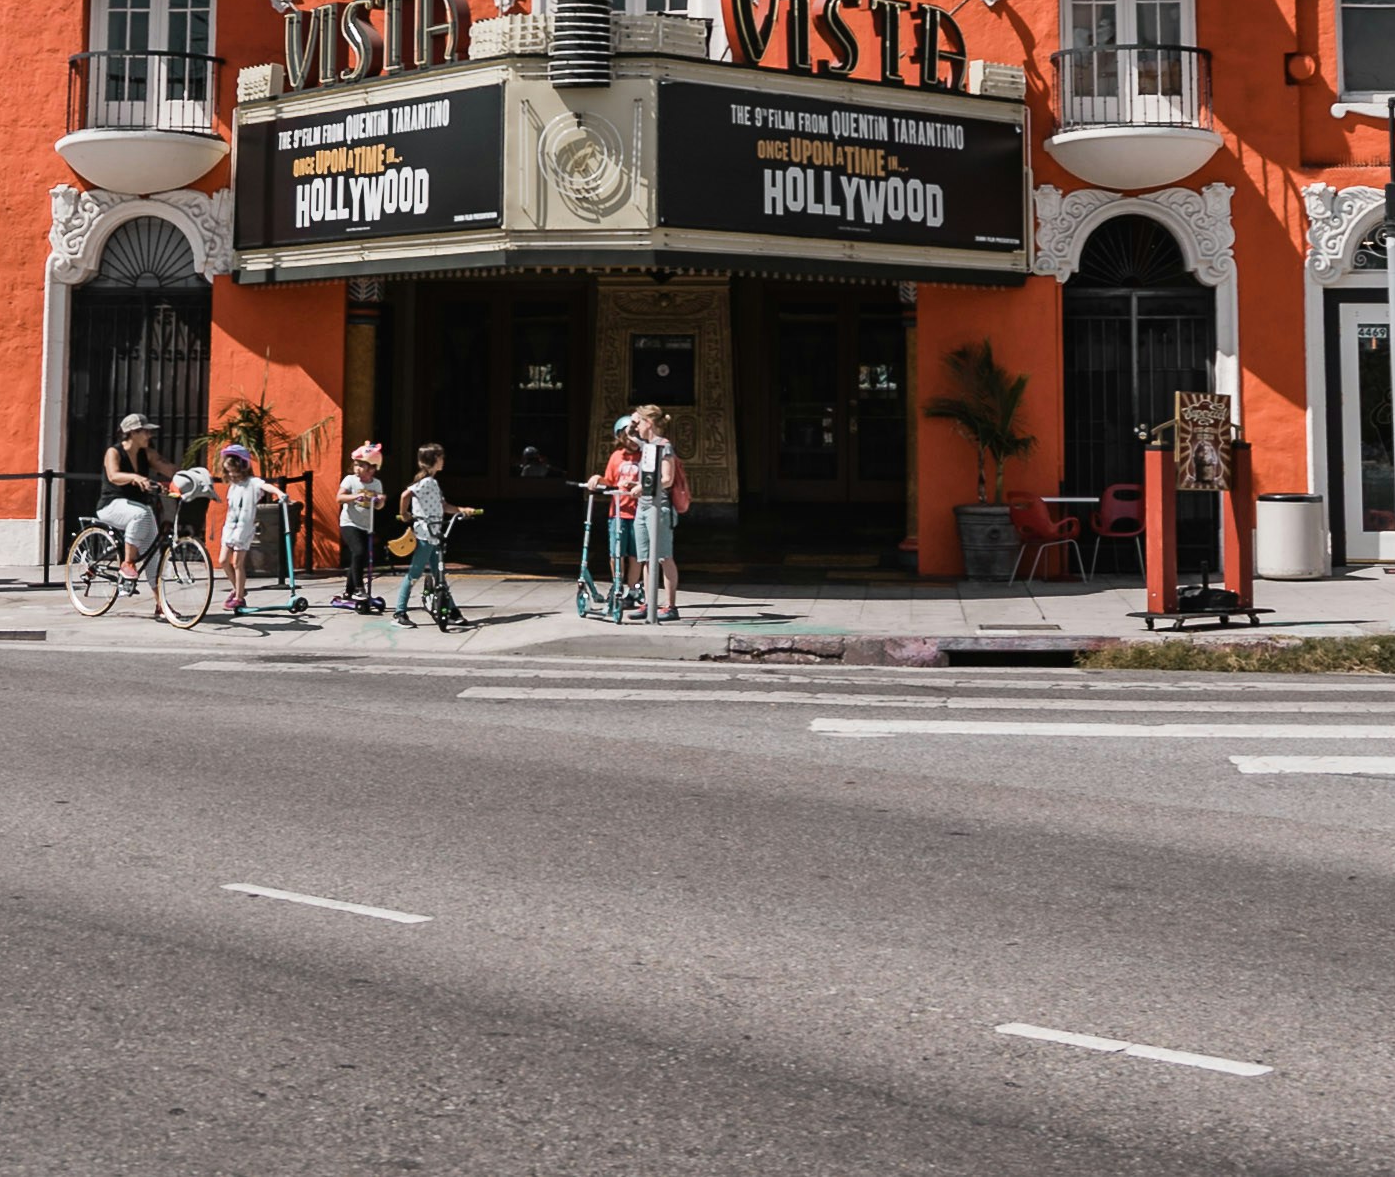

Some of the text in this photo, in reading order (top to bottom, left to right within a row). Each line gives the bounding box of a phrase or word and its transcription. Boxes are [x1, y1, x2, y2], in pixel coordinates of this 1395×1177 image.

[278, 131, 293, 150] THE
[322, 122, 344, 144] FROM
[730, 104, 751, 125] THE
[798, 112, 828, 134] FROM
[293, 156, 315, 177] ONCE
[316, 147, 347, 175] UPON
[347, 149, 354, 169] A
[354, 143, 385, 175] TIME
[757, 139, 789, 161] ONCE
[790, 137, 834, 166] UPON
[836, 146, 844, 165] A
[845, 146, 886, 177] TIME
[295, 166, 429, 228] HOLLYWOOD
[764, 166, 944, 227] HOLLYWOOD
[1358, 328, 1387, 337] 4469
